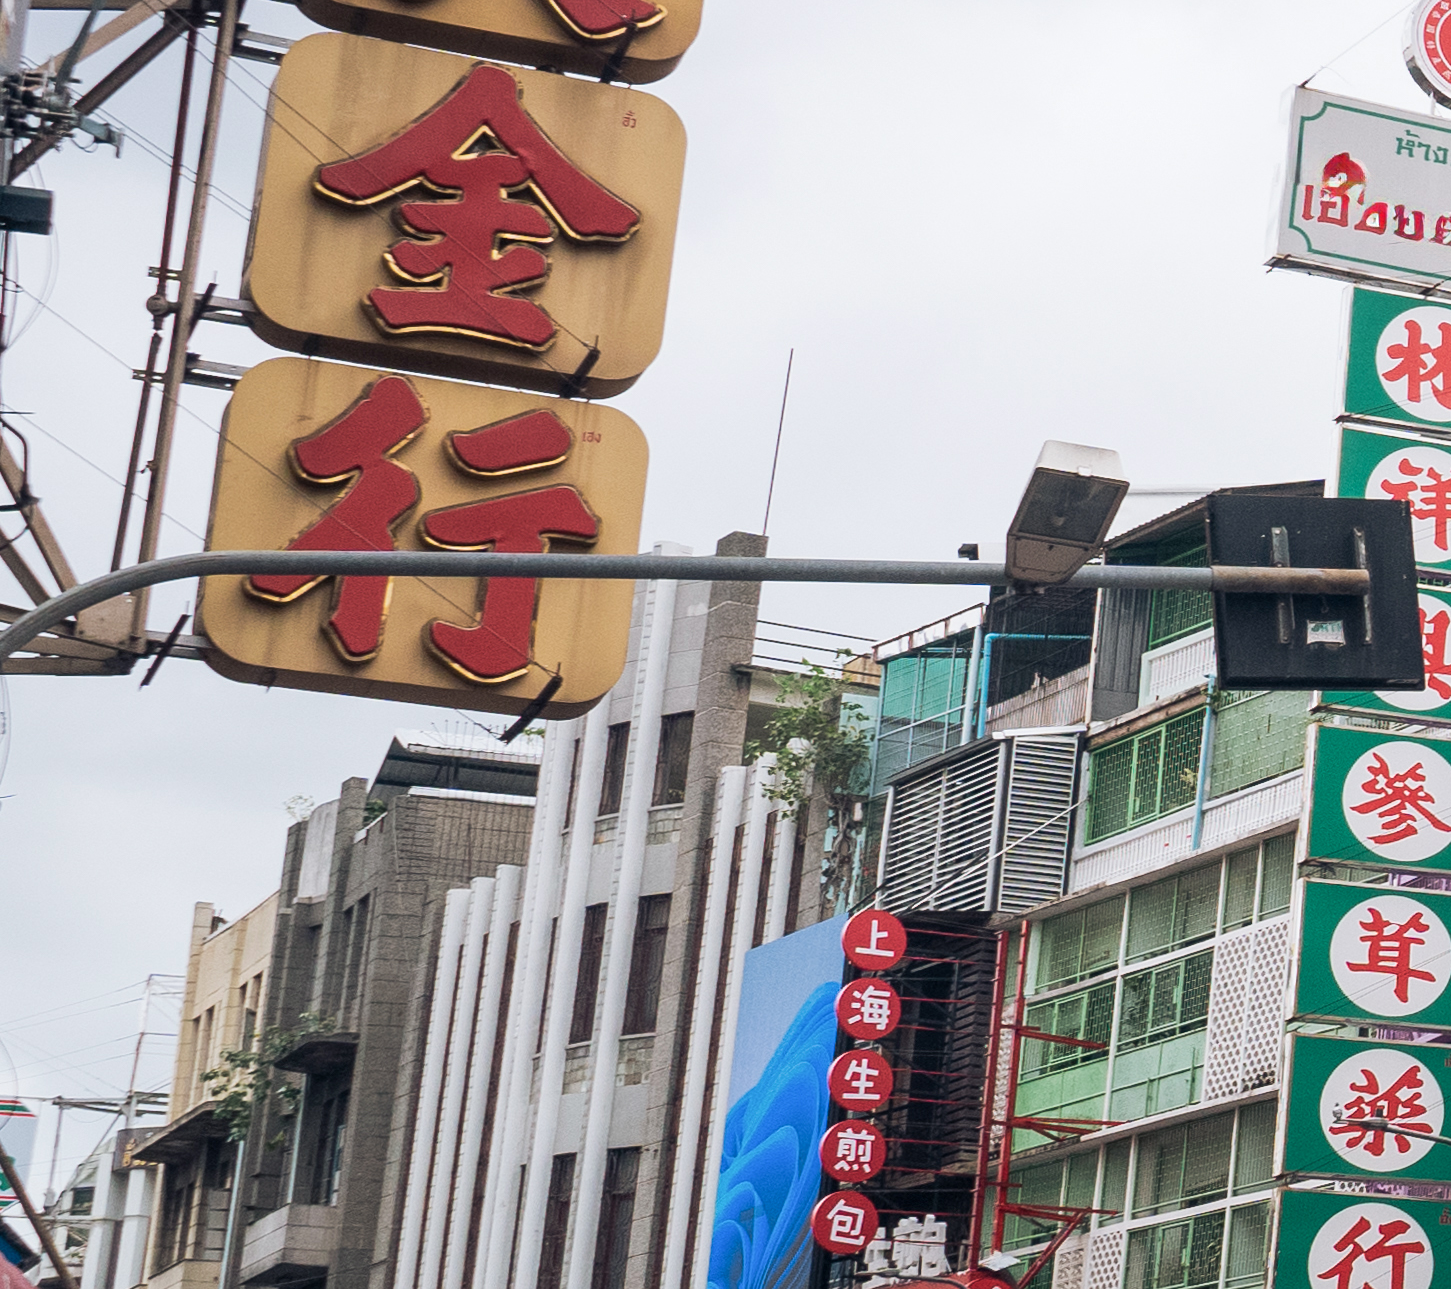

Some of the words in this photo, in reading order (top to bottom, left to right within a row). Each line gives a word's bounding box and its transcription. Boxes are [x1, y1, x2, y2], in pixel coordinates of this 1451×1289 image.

[825, 918, 896, 1245] 上海生煎包
